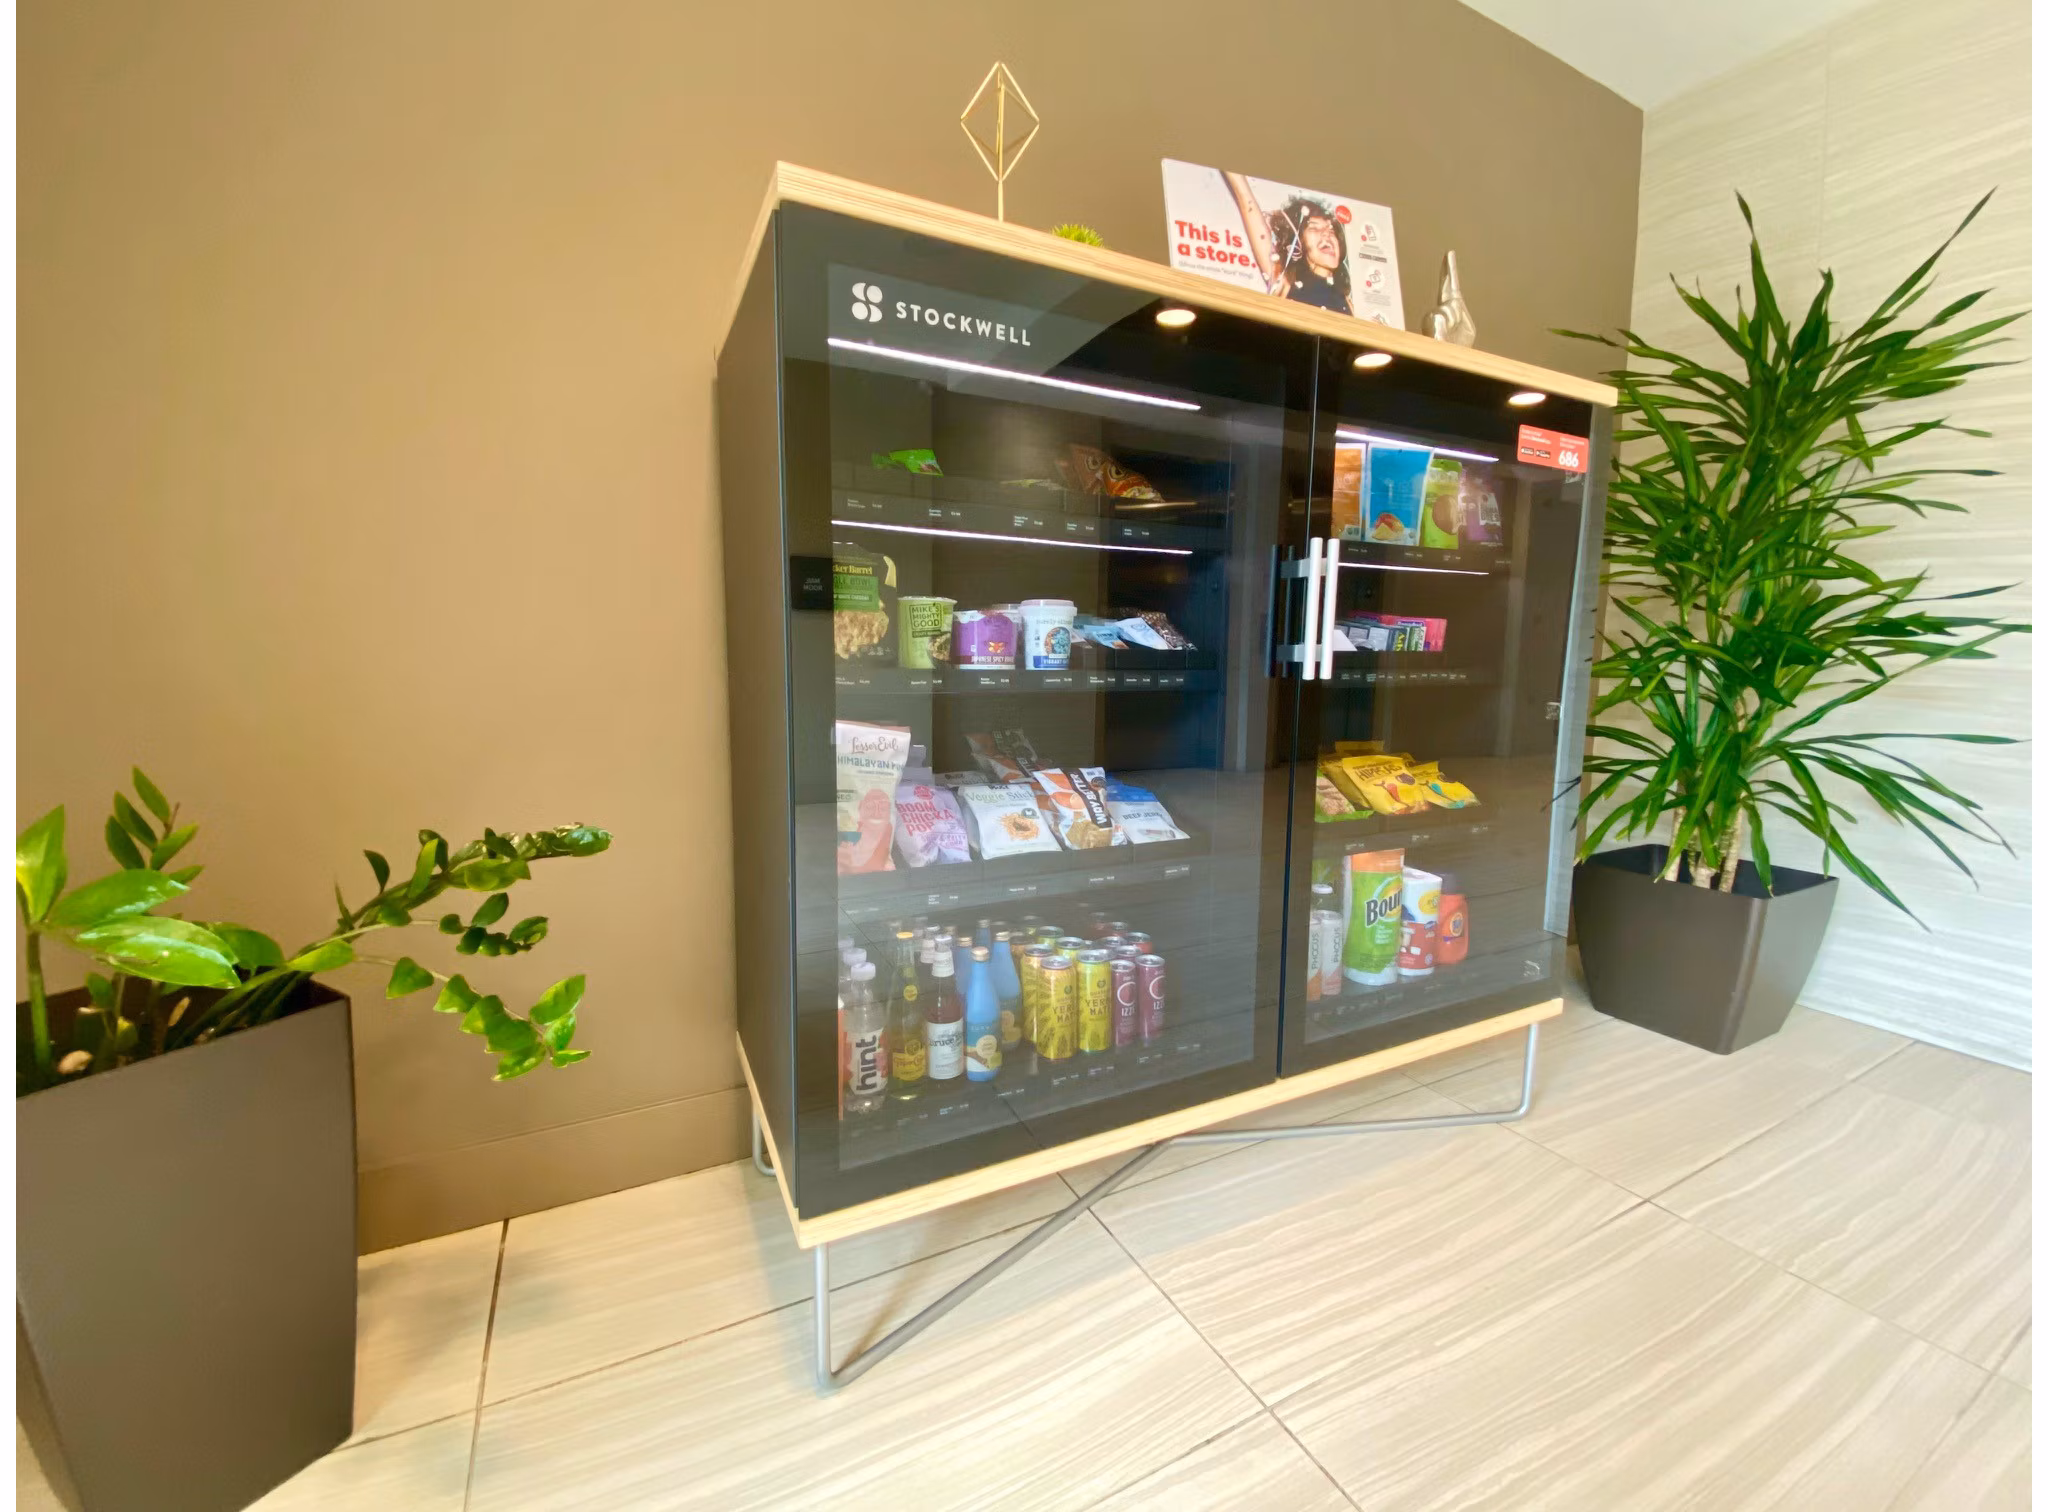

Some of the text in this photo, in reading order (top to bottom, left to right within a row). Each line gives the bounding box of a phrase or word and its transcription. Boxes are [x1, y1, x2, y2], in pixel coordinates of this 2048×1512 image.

[1174, 219, 1242, 248] This is
[1177, 242, 1257, 270] a store.
[896, 301, 1032, 346] STOCKWELL
[1558, 449, 1579, 468] 686
[833, 565, 848, 573] cker
[912, 603, 939, 613] MIKE'S
[913, 619, 940, 627] GOOD
[966, 790, 1006, 803] Veggie
[896, 802, 937, 813] BOOM
[901, 809, 954, 824] CHICKA
[906, 822, 934, 836] POP
[1312, 932, 1320, 970] PHOCUS
[1333, 926, 1341, 964] PHOCUS
[1052, 1004, 1073, 1014] YER
[1086, 998, 1108, 1008] YER
[1153, 1001, 1165, 1010] IZZ
[1057, 1012, 1075, 1022] MAT
[1090, 1006, 1108, 1016] MAT
[1121, 1007, 1135, 1016] IZZ
[856, 1035, 877, 1091] hint
